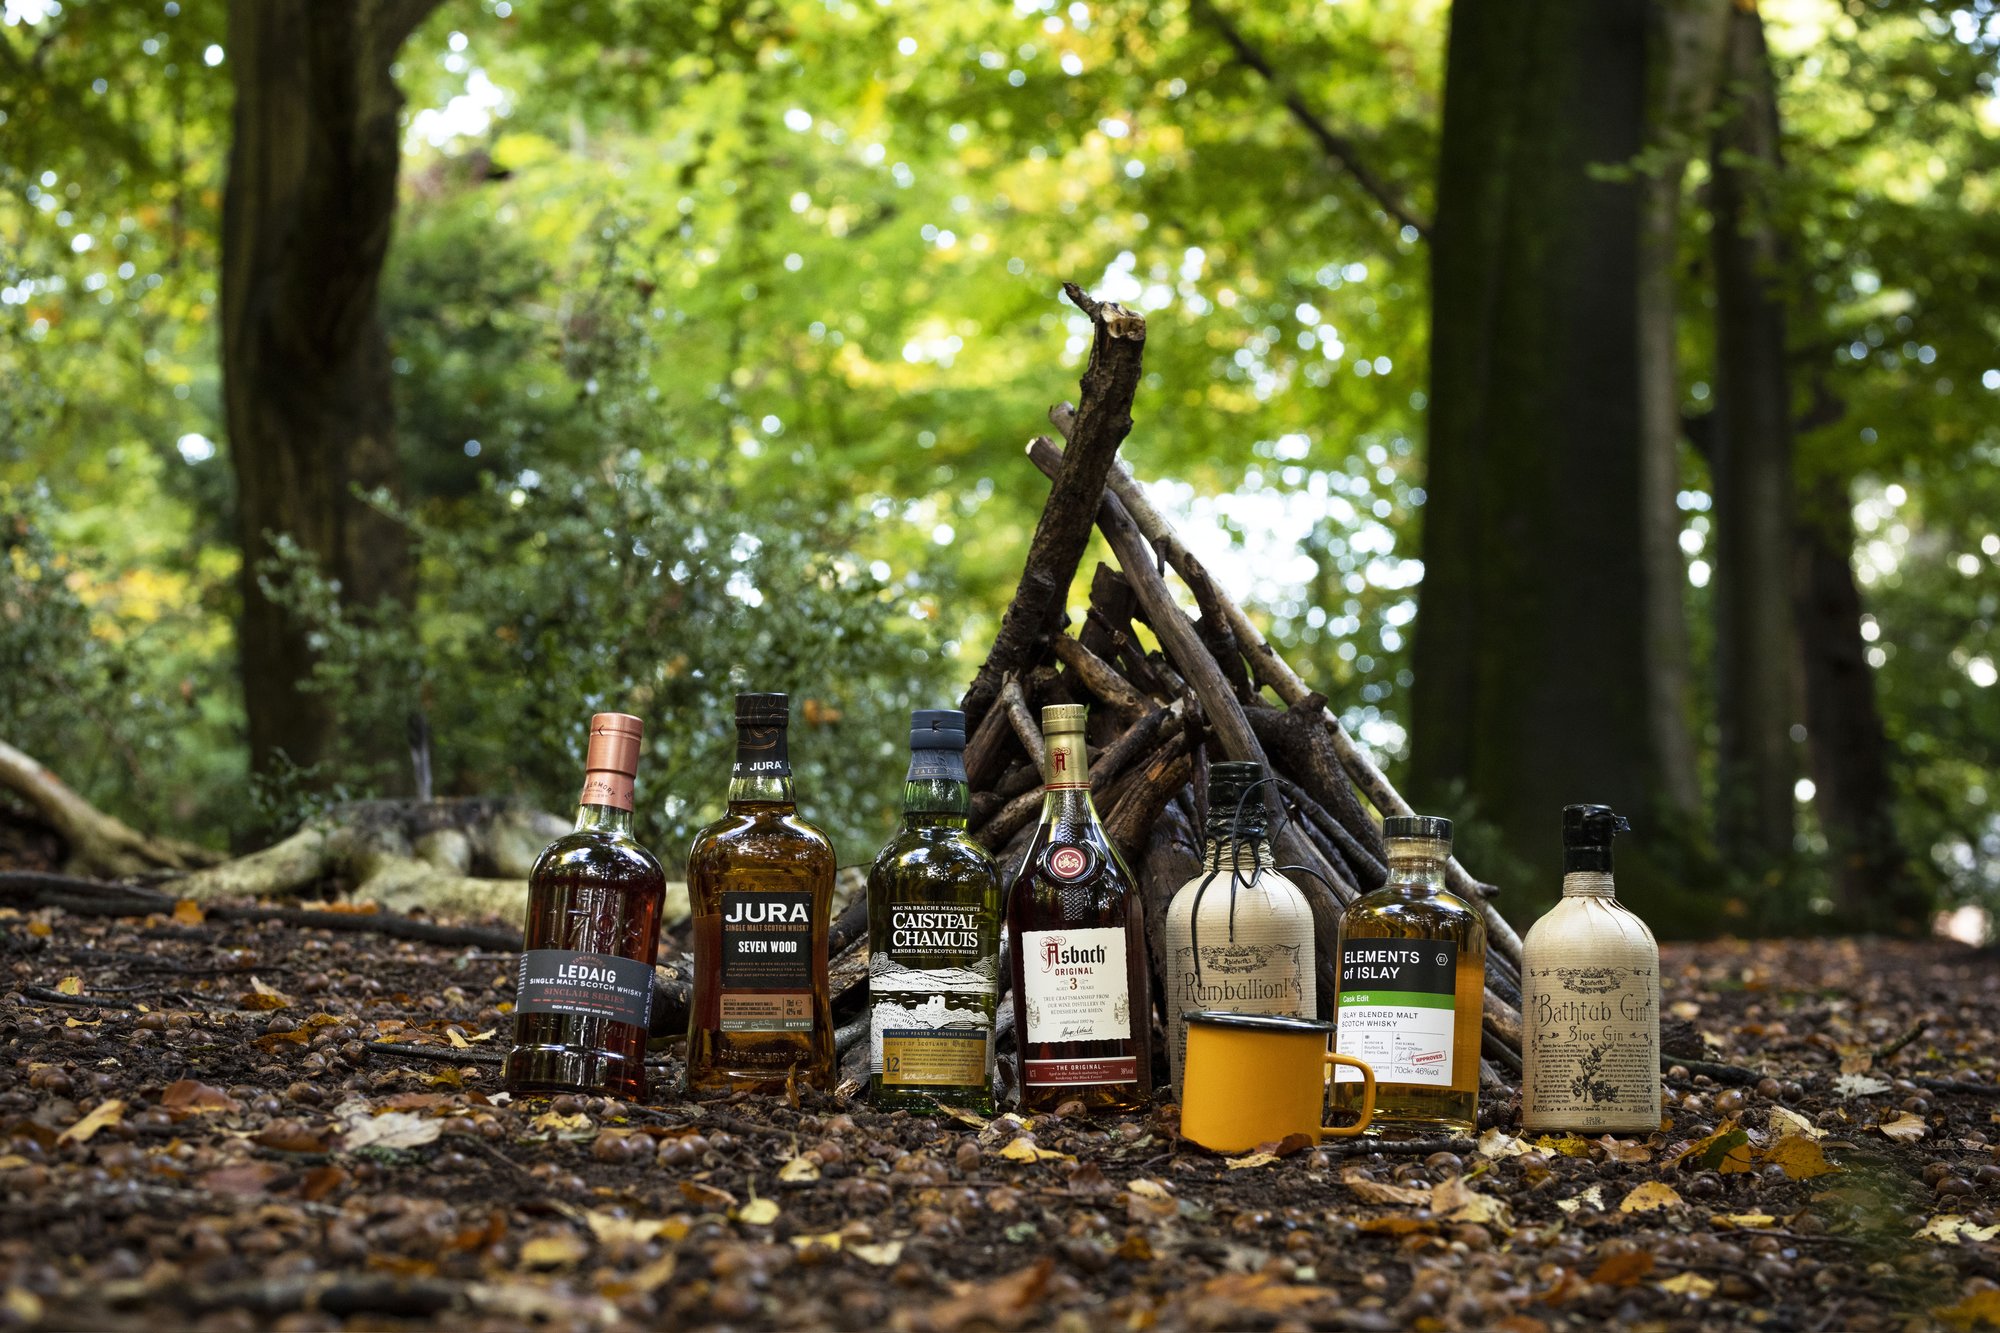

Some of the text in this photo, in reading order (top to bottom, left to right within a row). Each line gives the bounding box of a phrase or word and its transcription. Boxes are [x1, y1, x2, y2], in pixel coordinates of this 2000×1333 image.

[750, 761, 782, 771] JURA
[725, 902, 808, 922] JURA
[892, 912, 979, 930] CAISTEAL
[738, 941, 797, 952] SEVEN WOOD
[892, 930, 979, 947] CHAMUIS
[1040, 936, 1106, 973] Asbach
[1344, 950, 1420, 964] ELEMENTS
[558, 964, 617, 983] LEDAIG
[1055, 967, 1094, 976] ORIGINAL
[1344, 966, 1400, 980] of ISLAY
[580, 980, 614, 991] SCOTCH
[617, 986, 642, 998] WHISKY
[1070, 978, 1077, 990] 3
[1185, 972, 1288, 1007] Rumbullion!
[544, 988, 624, 1003] SINCLAIR SERIES
[1538, 993, 1646, 1027] Bathtub Gin
[1564, 1026, 1623, 1043] Sloe Gin
[886, 1057, 900, 1072] 12
[1416, 1054, 1442, 1062] APPROVED
